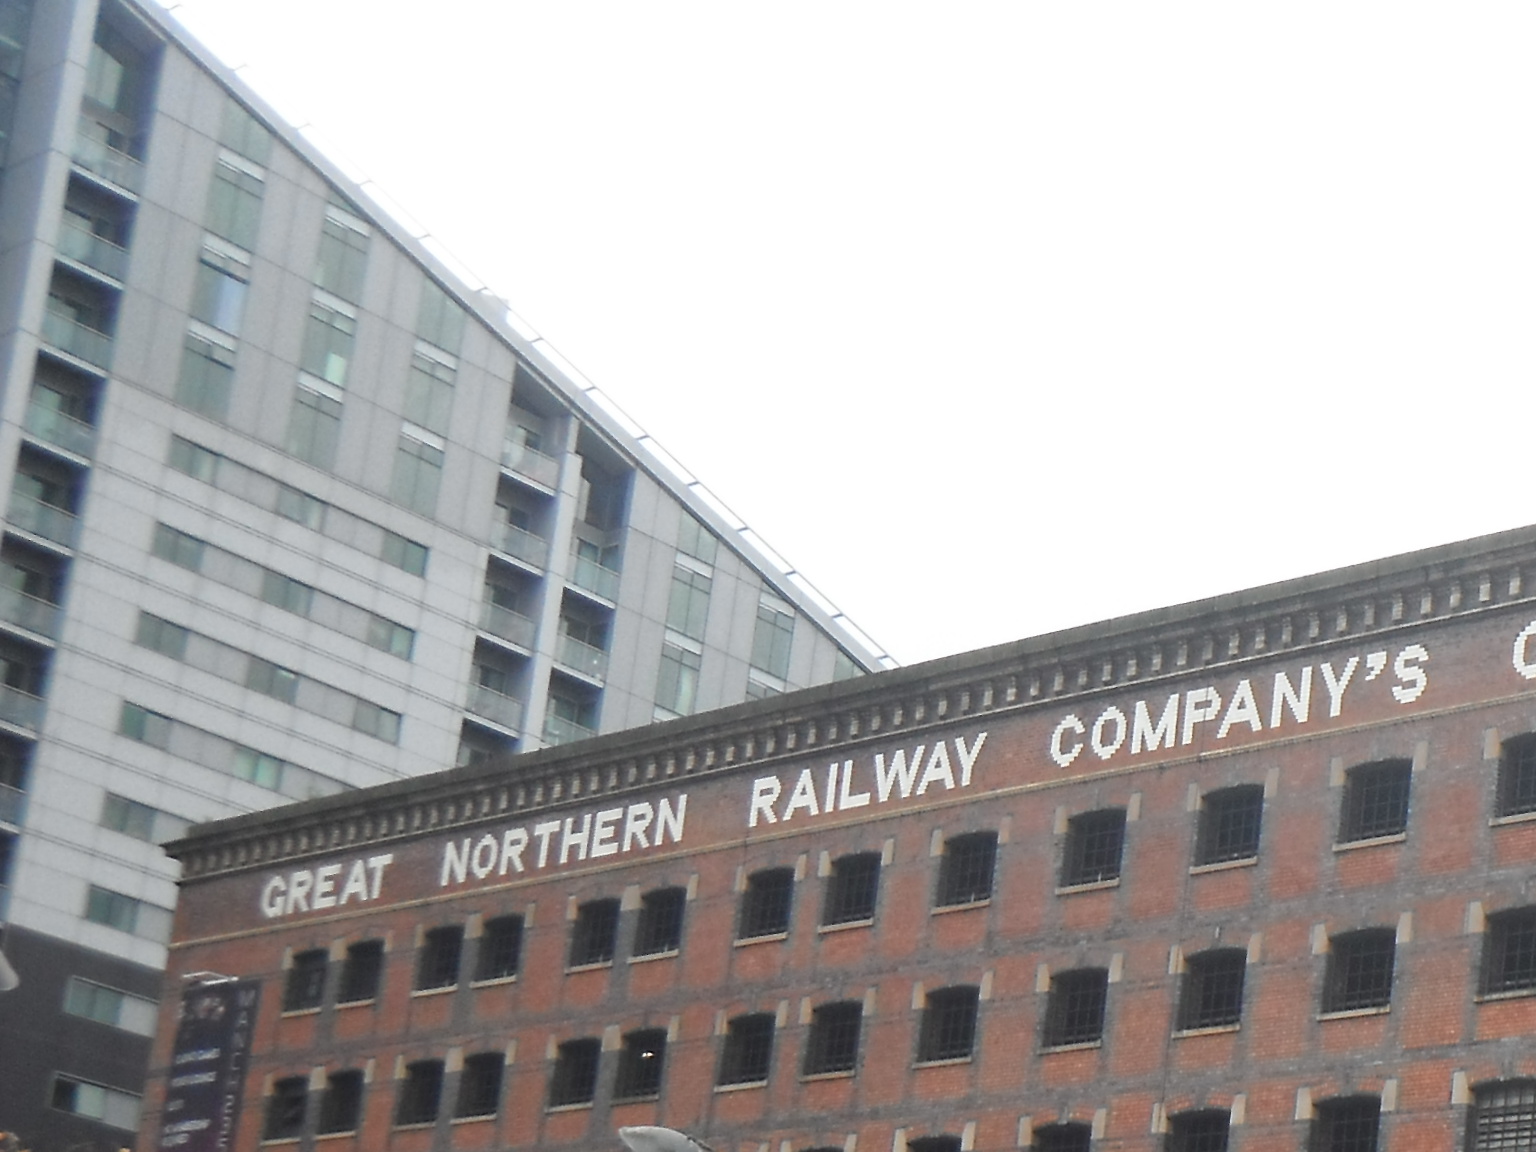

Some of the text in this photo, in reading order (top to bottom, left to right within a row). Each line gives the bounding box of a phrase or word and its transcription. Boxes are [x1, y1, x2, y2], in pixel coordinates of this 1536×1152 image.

[261, 853, 393, 919] GREAT
[440, 793, 688, 886] NORTHERN
[748, 731, 988, 828] RAILWAY
[1049, 643, 1430, 768] COMPANY'S
